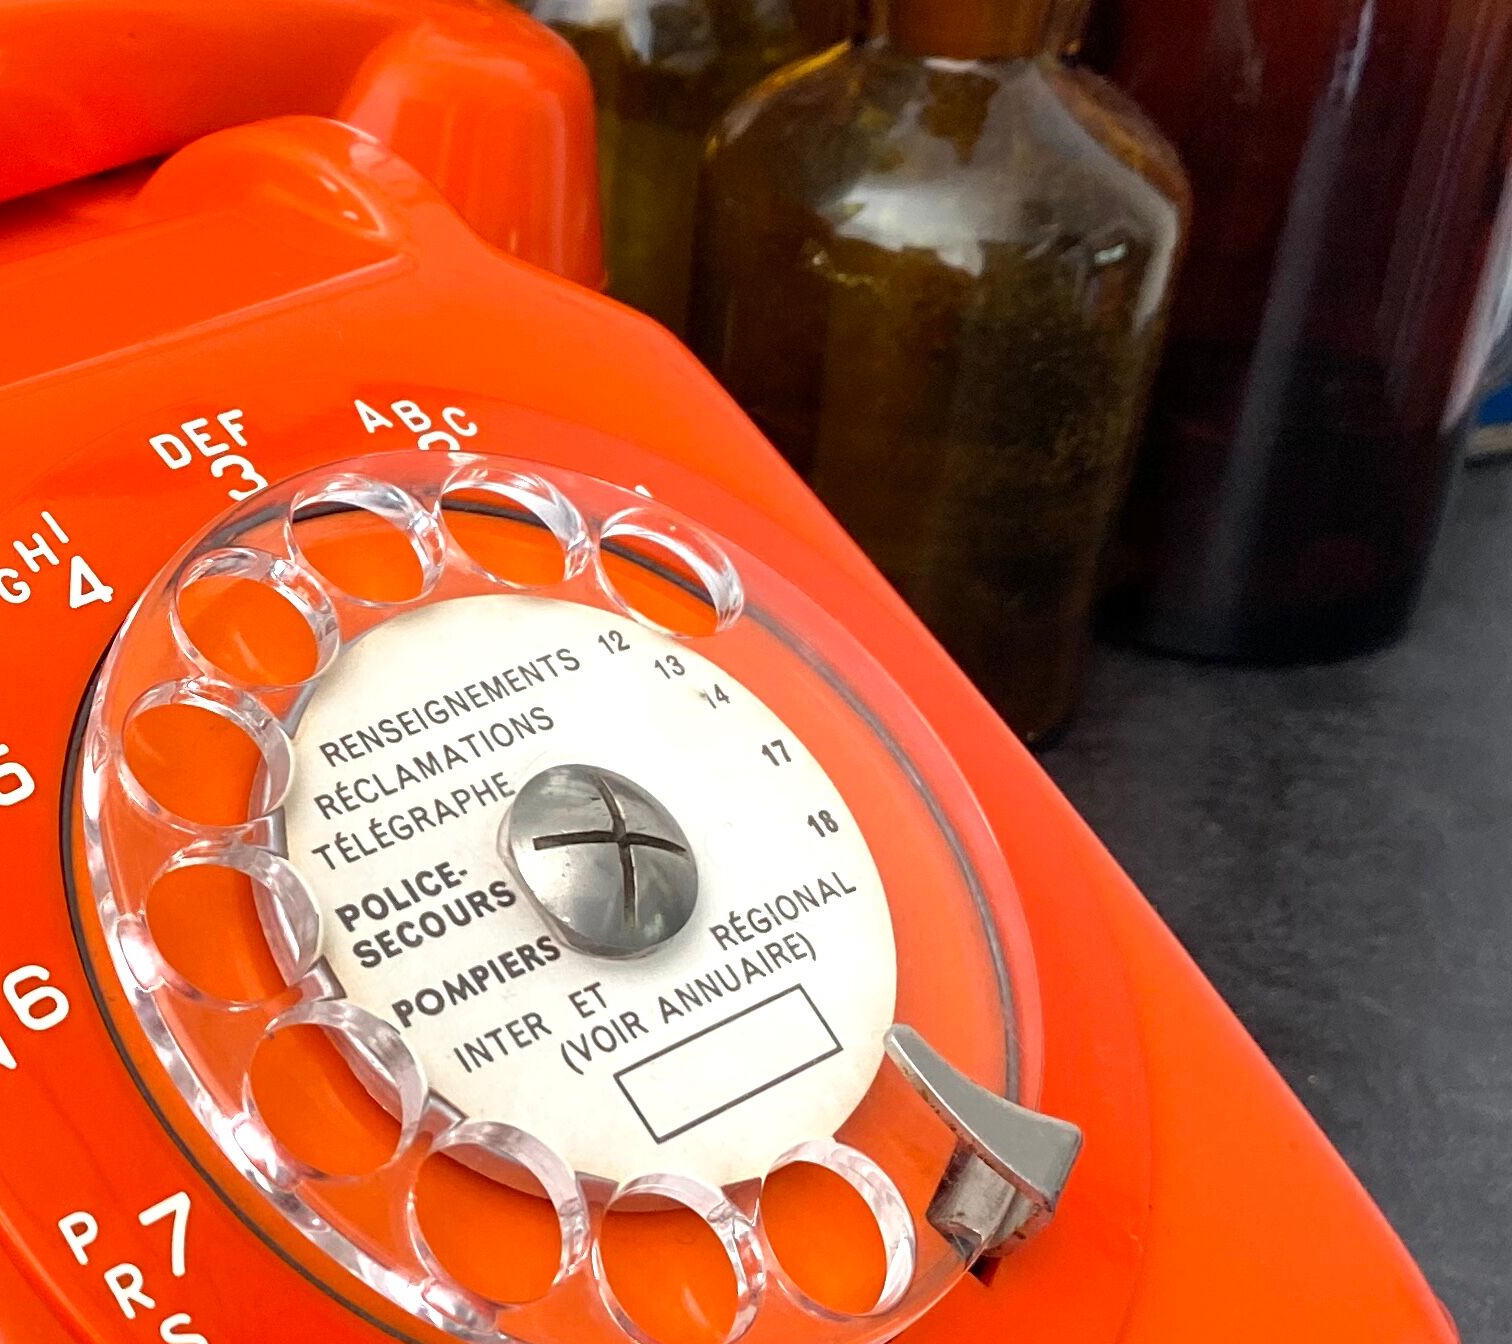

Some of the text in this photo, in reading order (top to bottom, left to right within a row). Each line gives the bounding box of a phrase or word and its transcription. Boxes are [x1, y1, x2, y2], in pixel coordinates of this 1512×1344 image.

[148, 409, 248, 469] DEF
[354, 399, 478, 437] ABC
[210, 454, 268, 502] 3
[69, 555, 114, 609] 4
[313, 654, 686, 820] RÉCLAMATIONS 13
[318, 629, 631, 767] RENSEIGNEMENTS 12
[312, 684, 731, 872] TÉLÉGRAPHE 14
[335, 860, 470, 932] POLICE-
[352, 739, 792, 969] SECOURS 17
[392, 809, 839, 1029] POMPIERS 18
[453, 870, 858, 1074] INTER ET RÉGIONAL
[3, 965, 69, 1030] 6
[559, 931, 818, 1075] (VOIR ANNUAIRE)
[139, 1192, 191, 1276] 7
